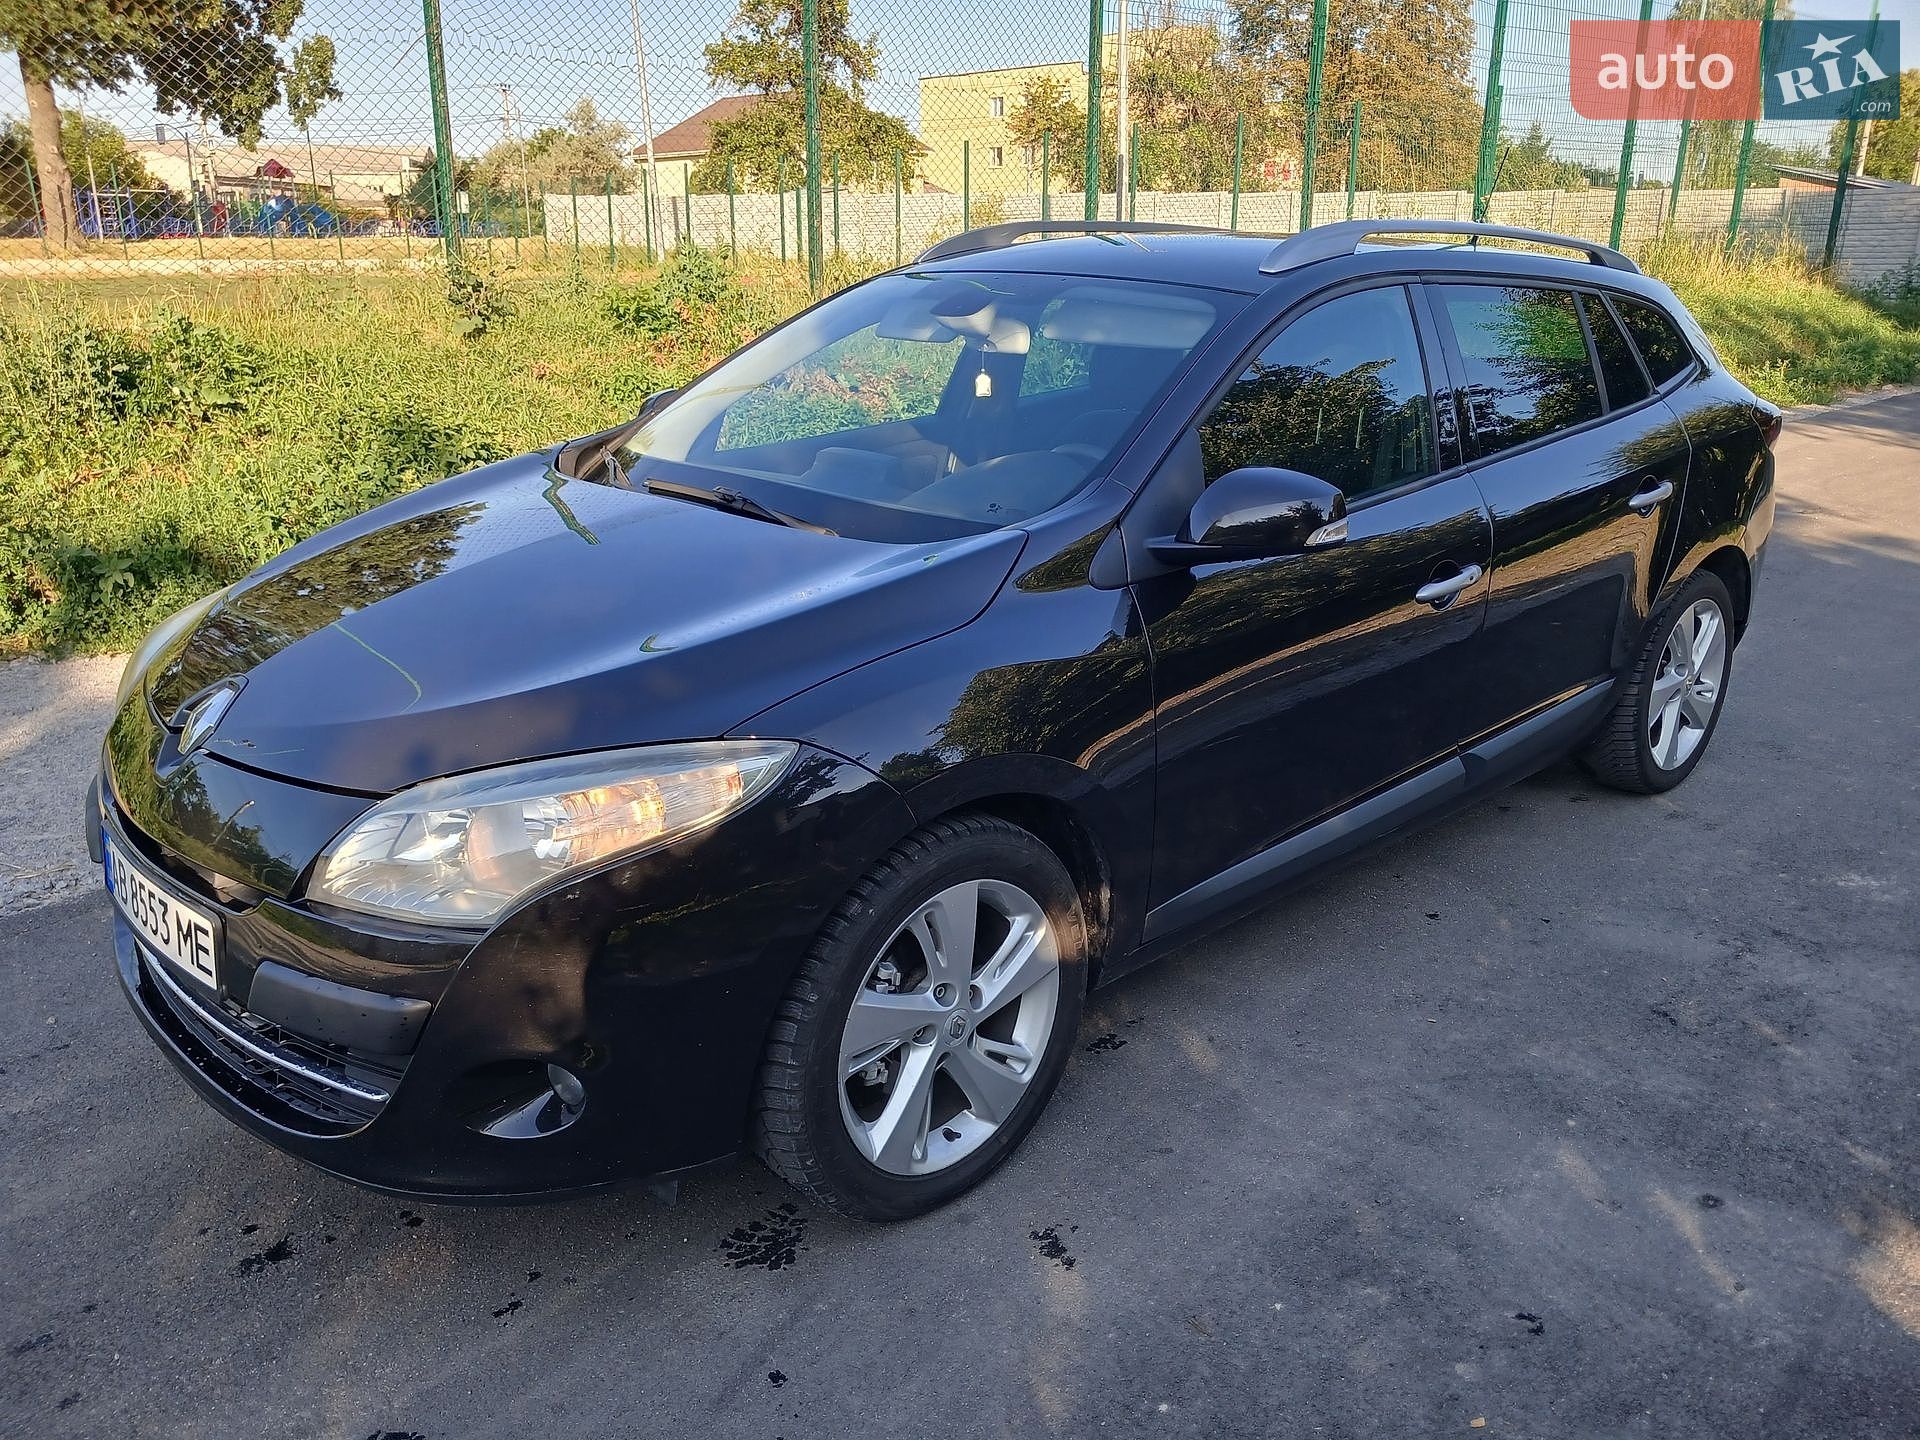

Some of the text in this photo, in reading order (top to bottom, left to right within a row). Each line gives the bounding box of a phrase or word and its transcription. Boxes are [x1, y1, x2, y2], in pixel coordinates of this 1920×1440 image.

[112, 850, 213, 978] AB 8553 ME
